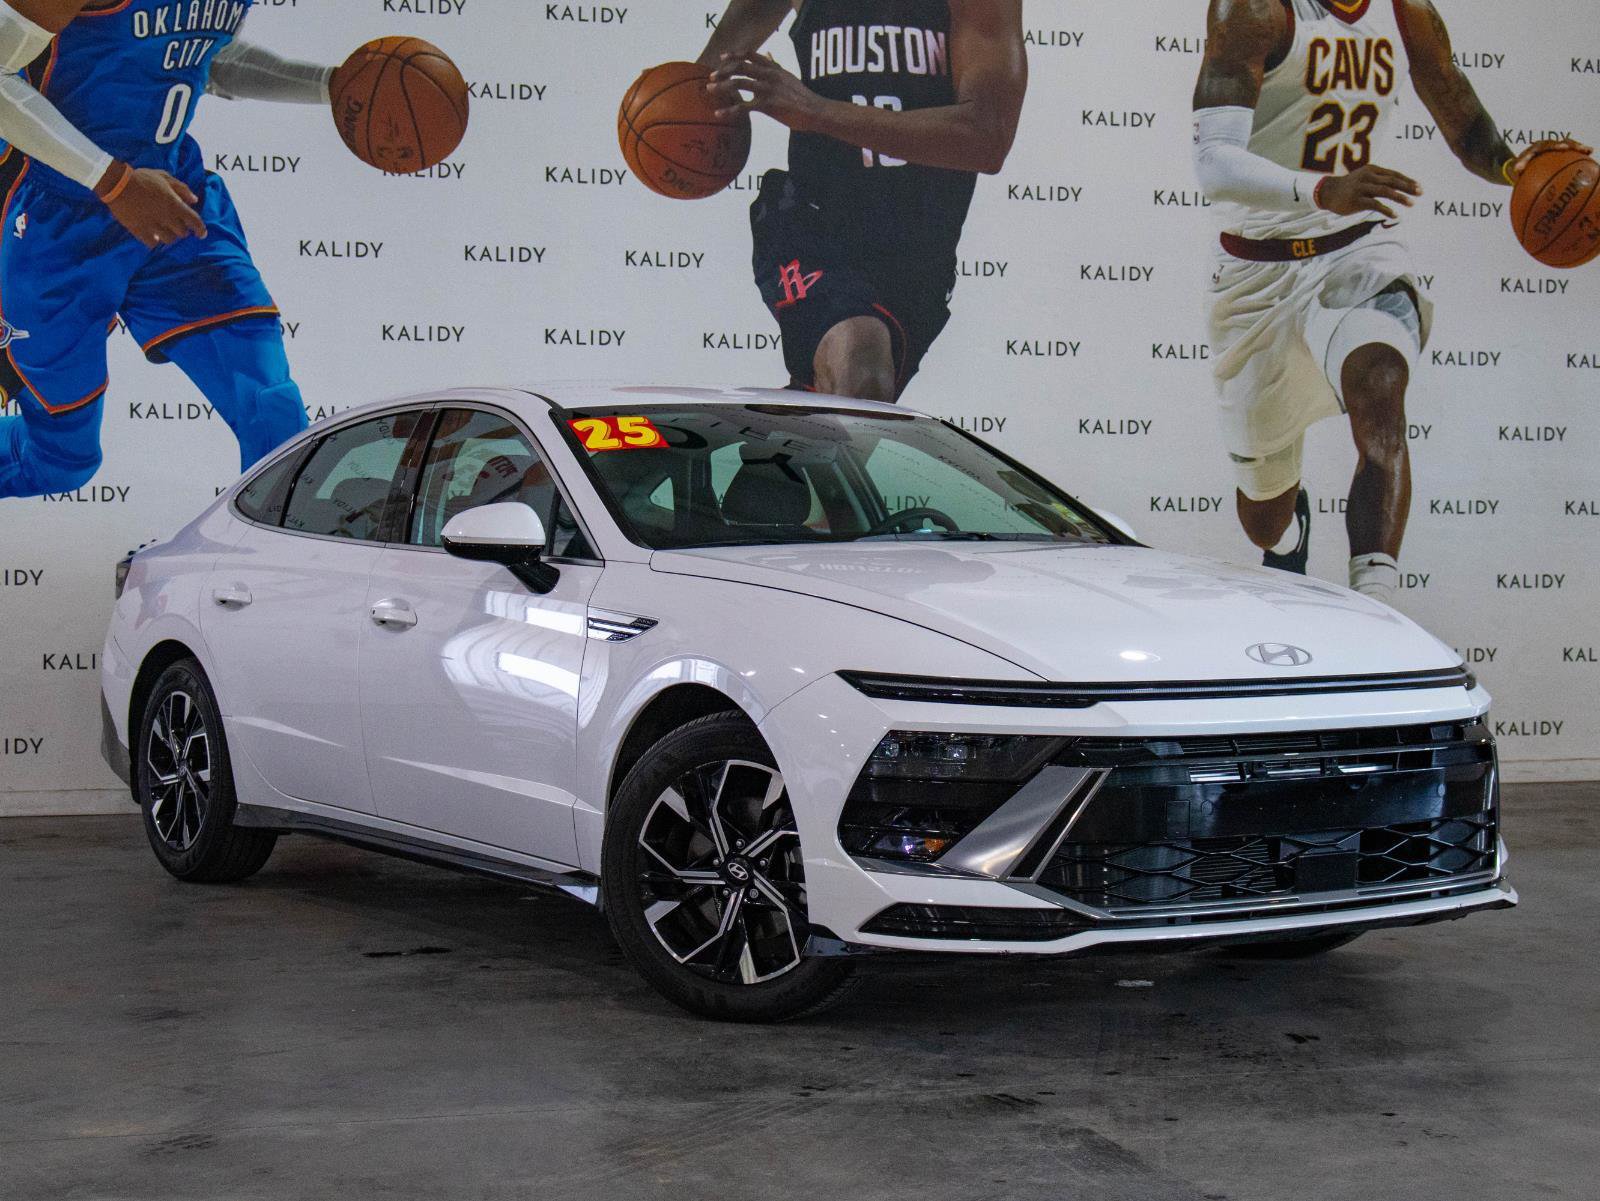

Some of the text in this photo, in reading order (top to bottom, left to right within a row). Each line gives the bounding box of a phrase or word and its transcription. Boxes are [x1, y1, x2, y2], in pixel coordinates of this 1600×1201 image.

[383, 0, 466, 15] KALIDY
[546, 4, 628, 24] KALIDY
[1023, 29, 1084, 47] ALIDY
[1155, 36, 1208, 53] KALI
[163, 38, 215, 70] CITY
[810, 25, 947, 79] HOUSTON
[1452, 52, 1505, 69] ALIDY
[1305, 37, 1395, 97] CAVS
[1571, 57, 1600, 74] KAL
[465, 81, 547, 101] KALIDY
[155, 83, 192, 144] 0
[1082, 110, 1156, 128] KALIDY
[1301, 100, 1379, 174] 23
[1396, 124, 1436, 141] IDY
[216, 154, 301, 173] KALIDY
[546, 166, 627, 185] KALIDY
[1008, 184, 1083, 202] KALIDY
[1154, 189, 1212, 207] KALI
[1434, 201, 1503, 217] KALIDY
[300, 240, 384, 258] KALIDY
[464, 245, 547, 263] KALIDY
[1292, 238, 1317, 258] CLE
[625, 250, 705, 269] KALIDY
[955, 260, 1008, 277] LIDY
[1080, 265, 1154, 282] KALIDY
[1501, 278, 1569, 294] KALIDY
[382, 325, 465, 343] KALIDY
[544, 328, 626, 346] KALIDY
[703, 333, 782, 350] KALIDY
[1006, 340, 1081, 357] KALIDY
[1152, 343, 1209, 360] KALID
[1432, 350, 1501, 366] KALIDY
[1567, 353, 1600, 369] KAL
[129, 402, 215, 420] KALIDY
[573, 415, 662, 450] 25
[948, 416, 1007, 433] LIDY
[1078, 418, 1152, 435] KALIDY
[1498, 426, 1567, 442] KALIDY
[884, 496, 931, 511] LIDY
[1150, 496, 1223, 513] KALIDY
[1319, 498, 1348, 513] LID
[1430, 499, 1500, 515] KALIDY
[1565, 501, 1600, 516] KAL
[5, 569, 44, 586] IDY
[1399, 573, 1431, 589] IDY
[1496, 573, 1566, 589] KALIDY
[43, 653, 96, 670] KALI
[1466, 647, 1497, 663] IDY
[1563, 647, 1599, 663] KAL
[1495, 720, 1564, 737] KALIDY
[5, 738, 44, 755] IDY
